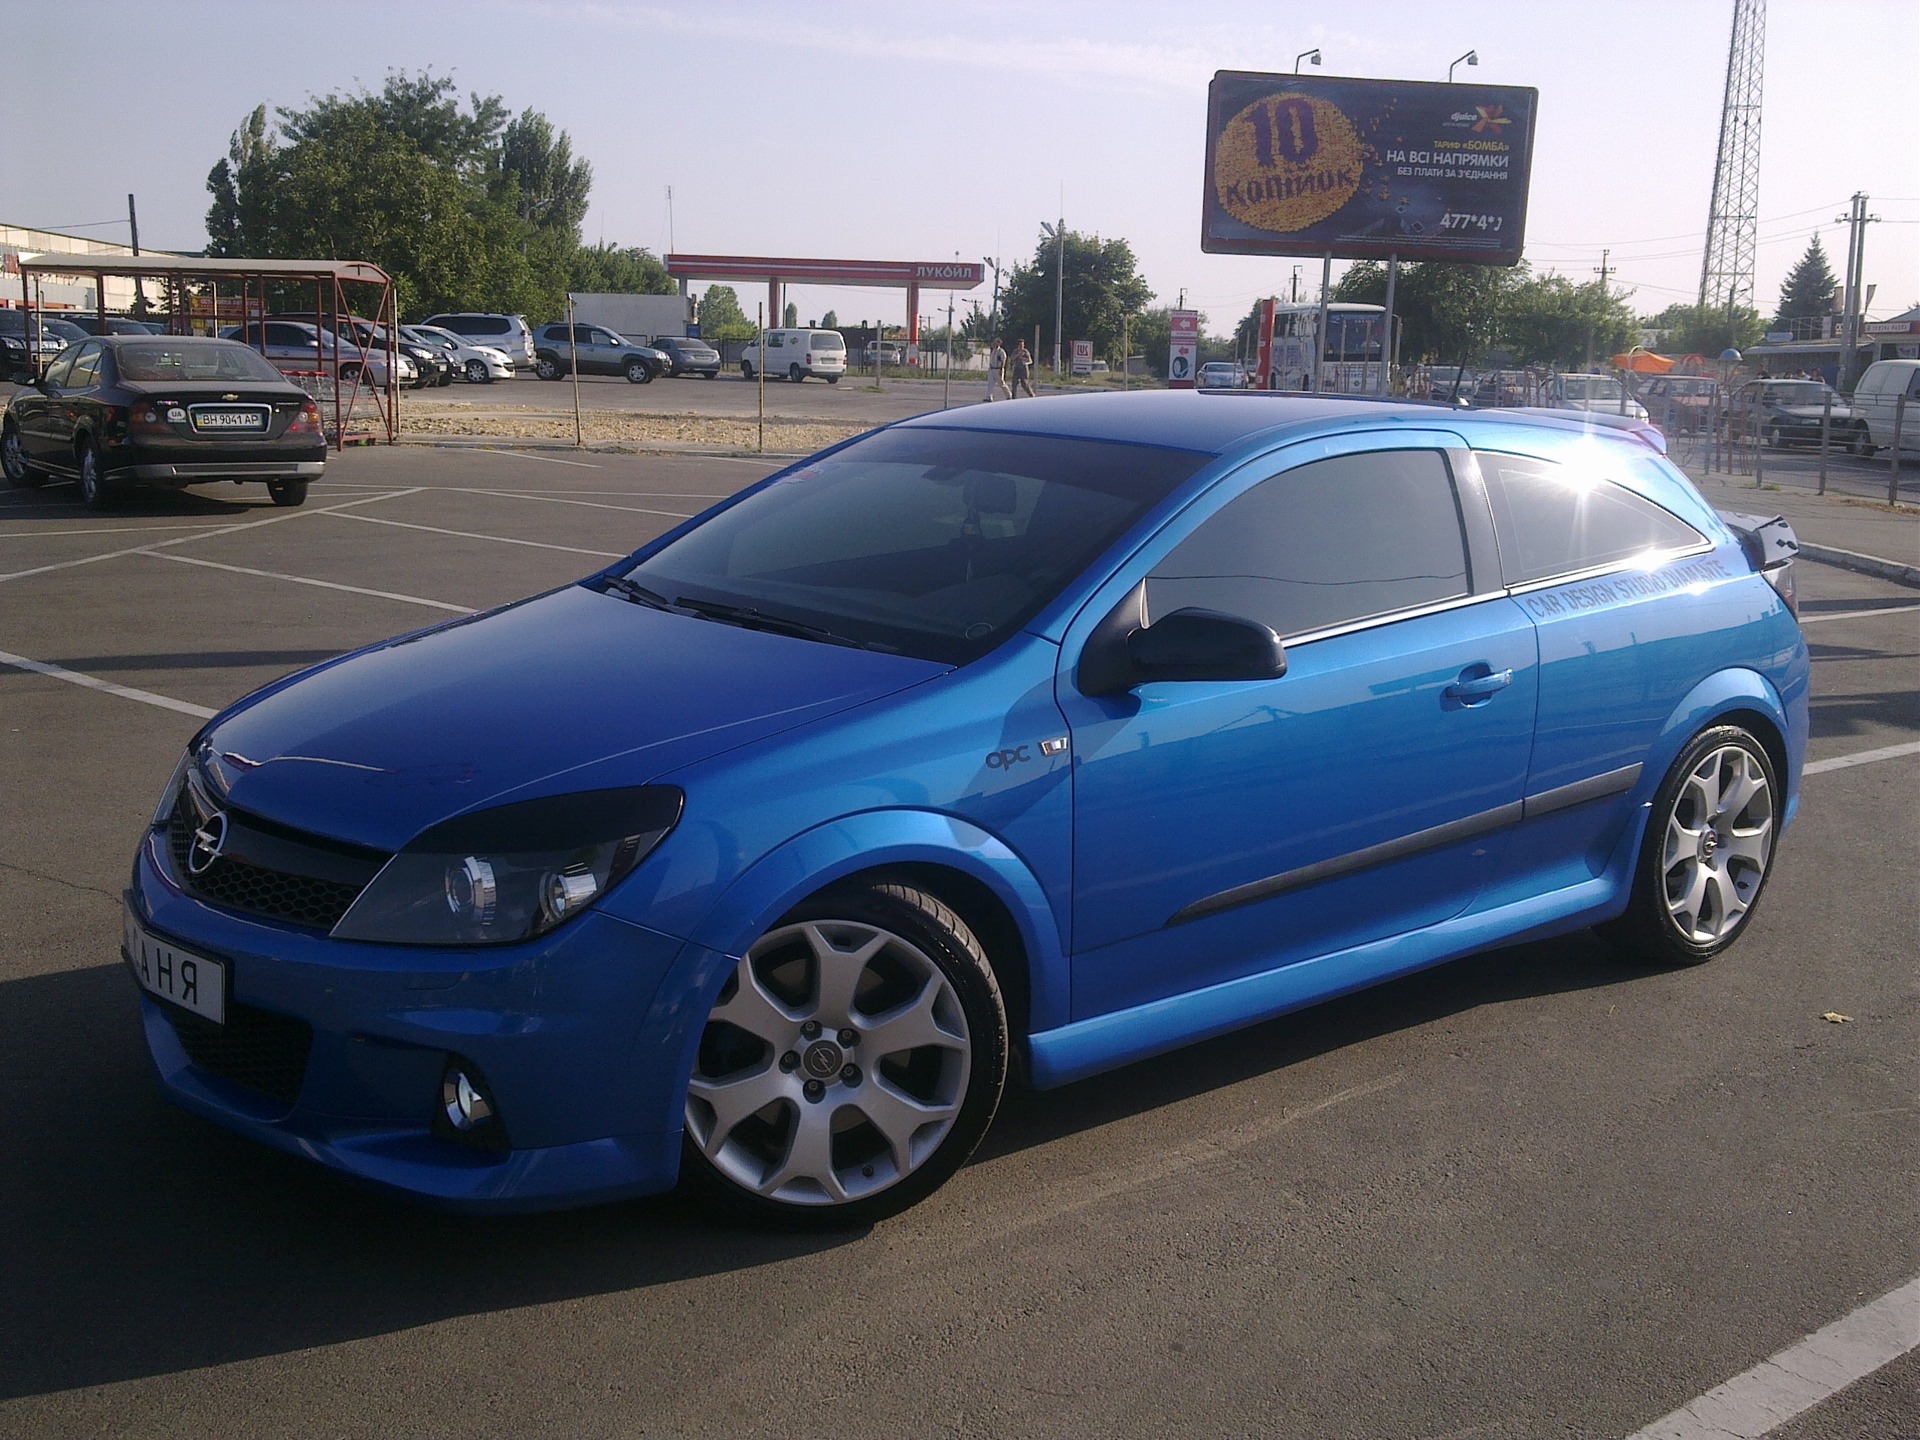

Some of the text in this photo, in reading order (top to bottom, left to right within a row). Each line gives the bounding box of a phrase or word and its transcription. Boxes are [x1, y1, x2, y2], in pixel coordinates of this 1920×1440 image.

[1451, 112, 1477, 121] djuice
[1244, 98, 1319, 167] 10
[1463, 141, 1509, 151] «БОМБА»
[1386, 150, 1509, 168] НА ВСІ НАПРЯМКИ
[1397, 167, 1412, 175] БЕЗ
[1414, 168, 1443, 176] ПЛАТИ
[1445, 169, 1456, 178] ЗА
[916, 265, 972, 278] ЛУКОЙЛ
[203, 414, 259, 425] BH 9041 AP
[1527, 595, 1563, 617] CAR
[1566, 584, 1618, 611] DESIGN
[1613, 573, 1667, 599] STUDIO
